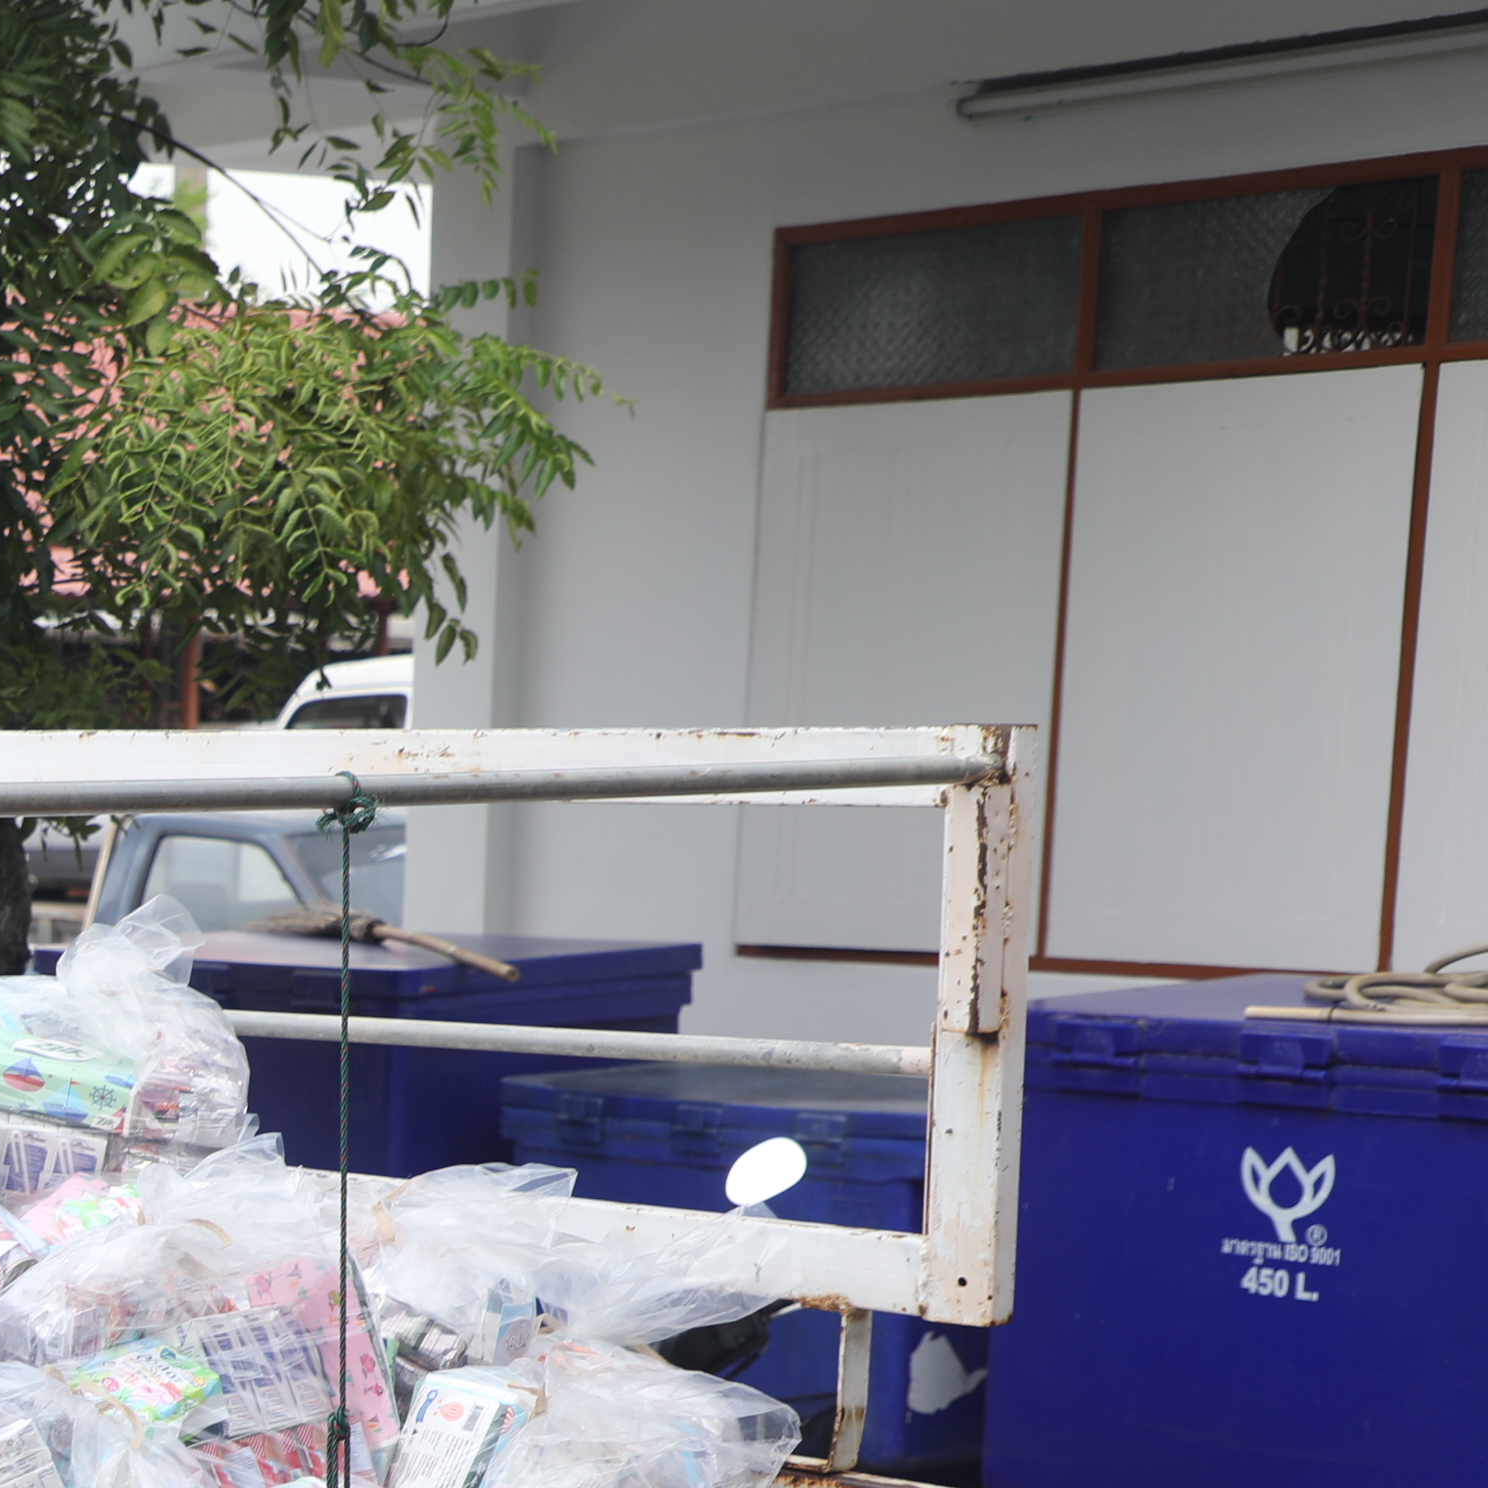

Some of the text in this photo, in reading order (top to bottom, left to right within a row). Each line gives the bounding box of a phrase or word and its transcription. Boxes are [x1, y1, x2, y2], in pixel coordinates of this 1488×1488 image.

[1284, 1243, 1309, 1263] ISO
[1309, 1246, 1341, 1266] 9001
[1240, 1266, 1320, 1302] 450 L.
